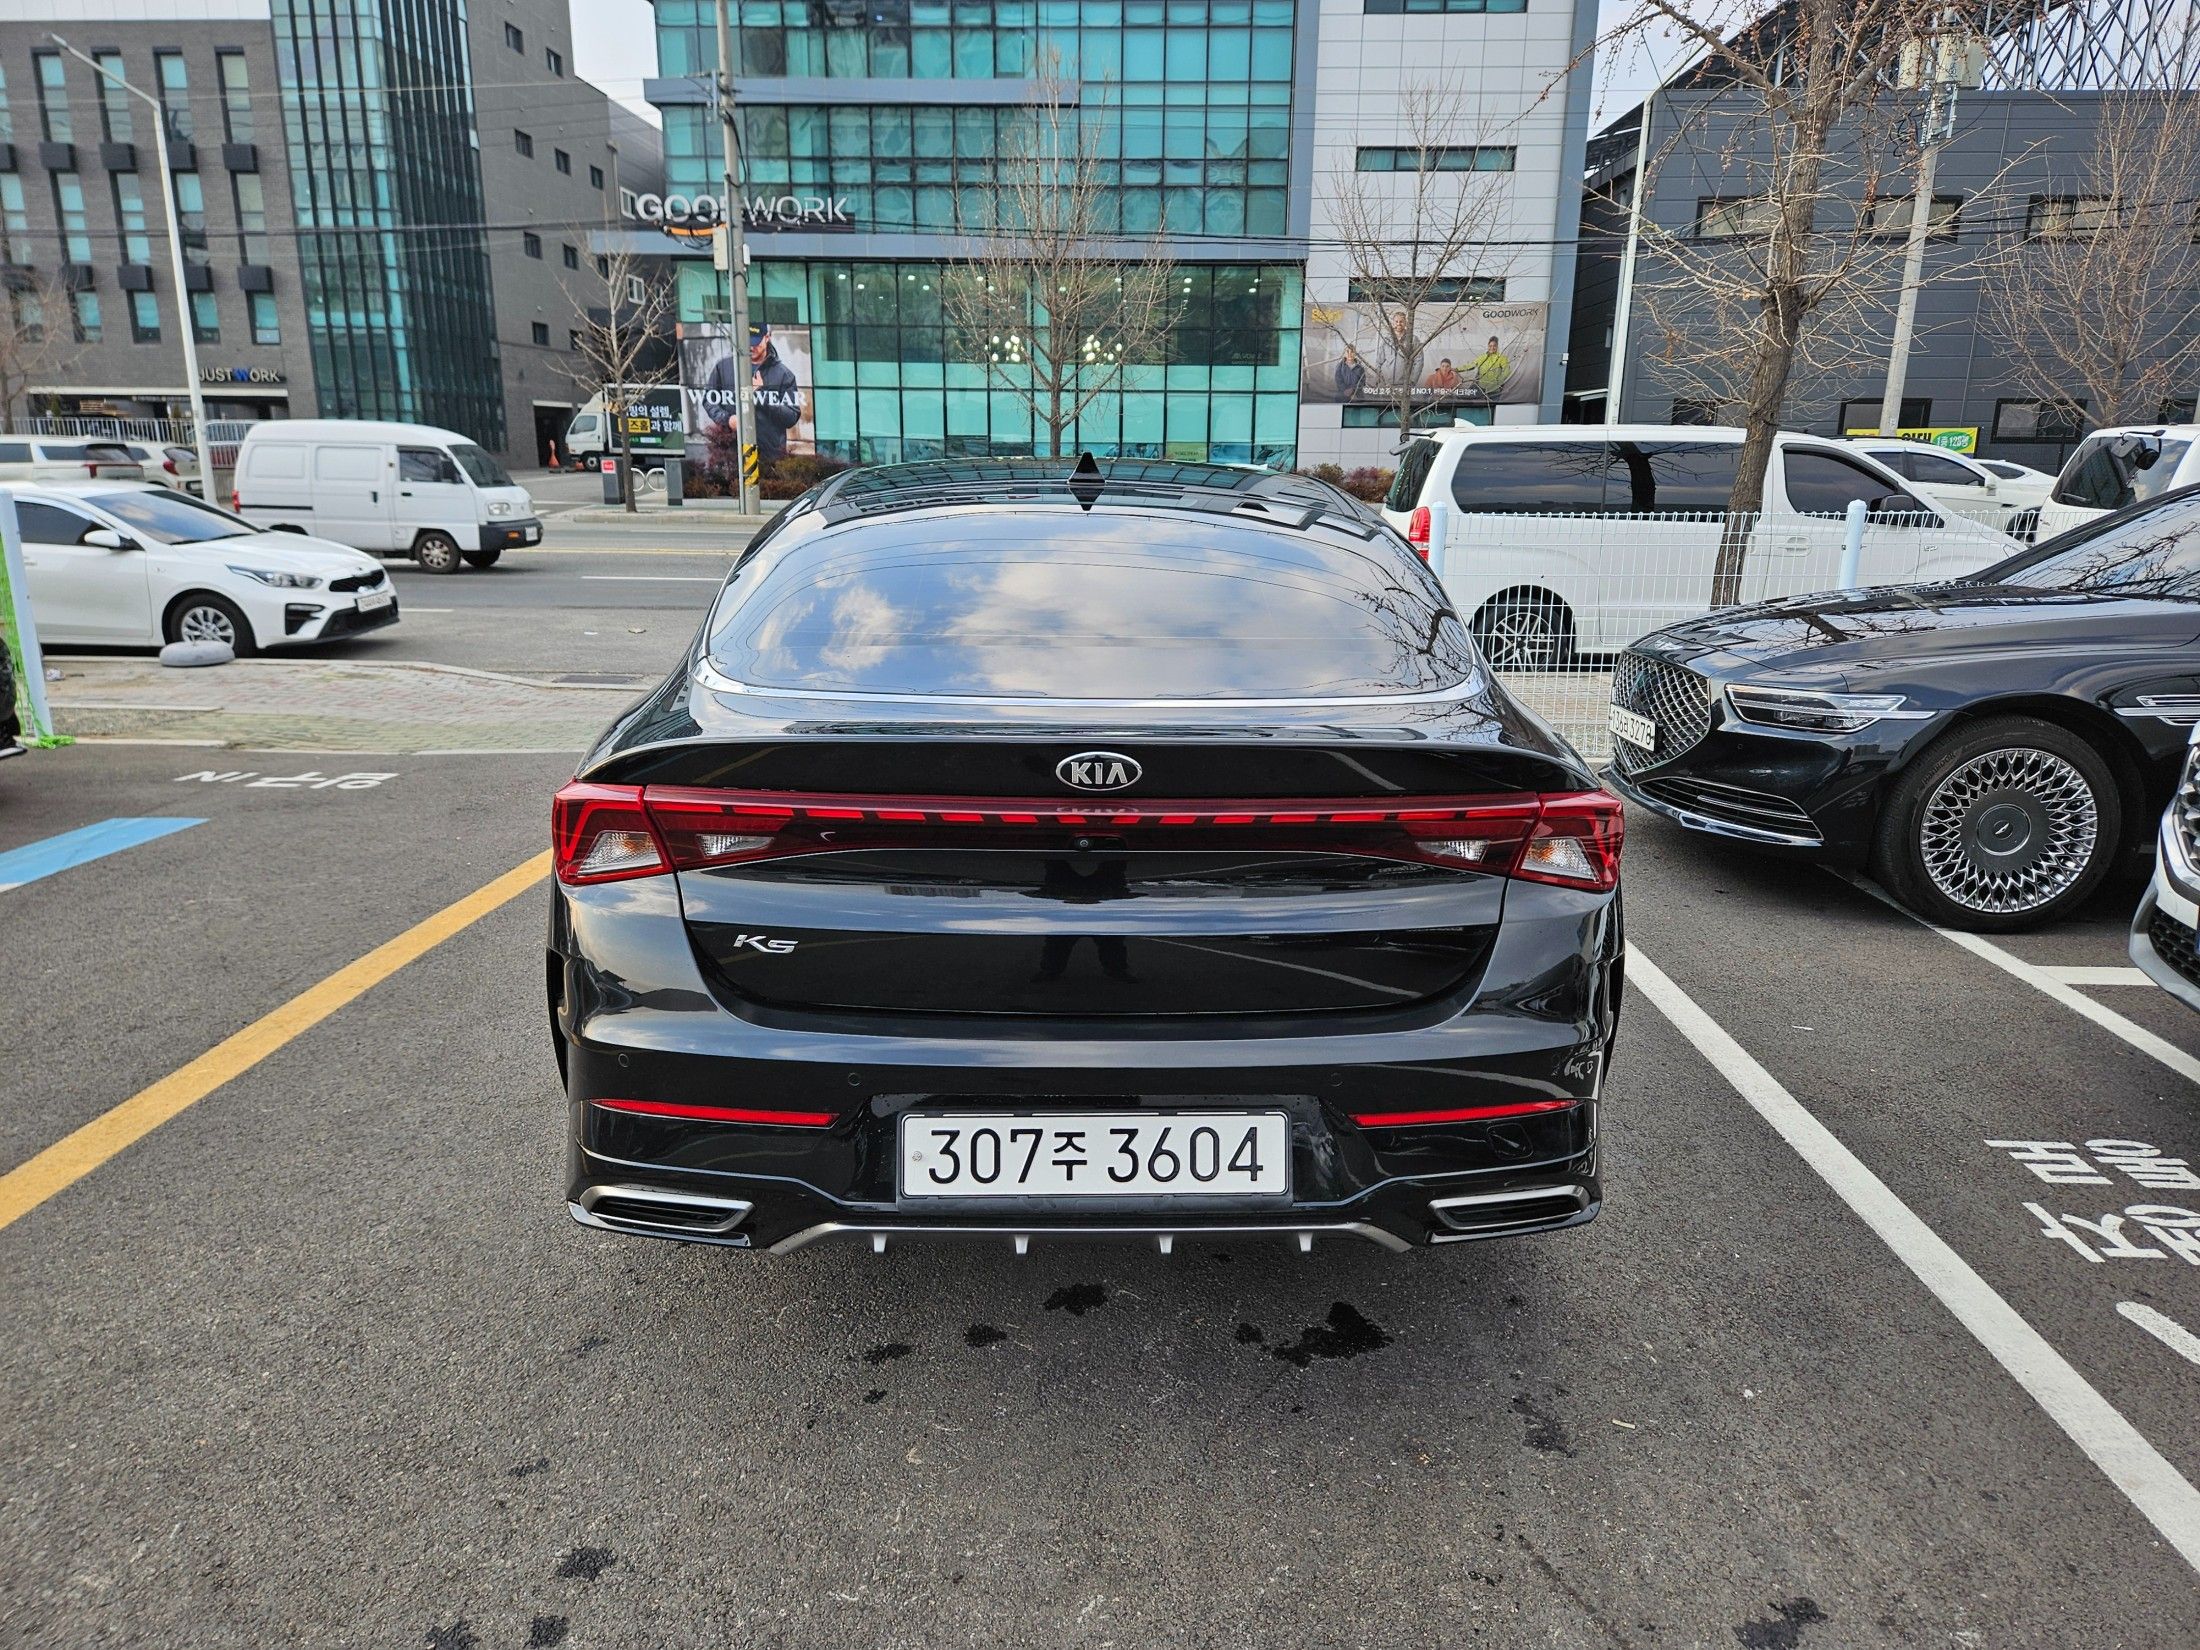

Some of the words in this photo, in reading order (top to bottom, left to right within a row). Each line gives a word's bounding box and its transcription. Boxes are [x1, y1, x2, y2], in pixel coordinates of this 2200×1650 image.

[687, 389, 807, 406] WORWEAR
[1070, 761, 1129, 785] KIA
[733, 934, 799, 954] K5
[928, 1127, 1088, 1184] 307주
[1107, 1126, 1264, 1183] 3604
